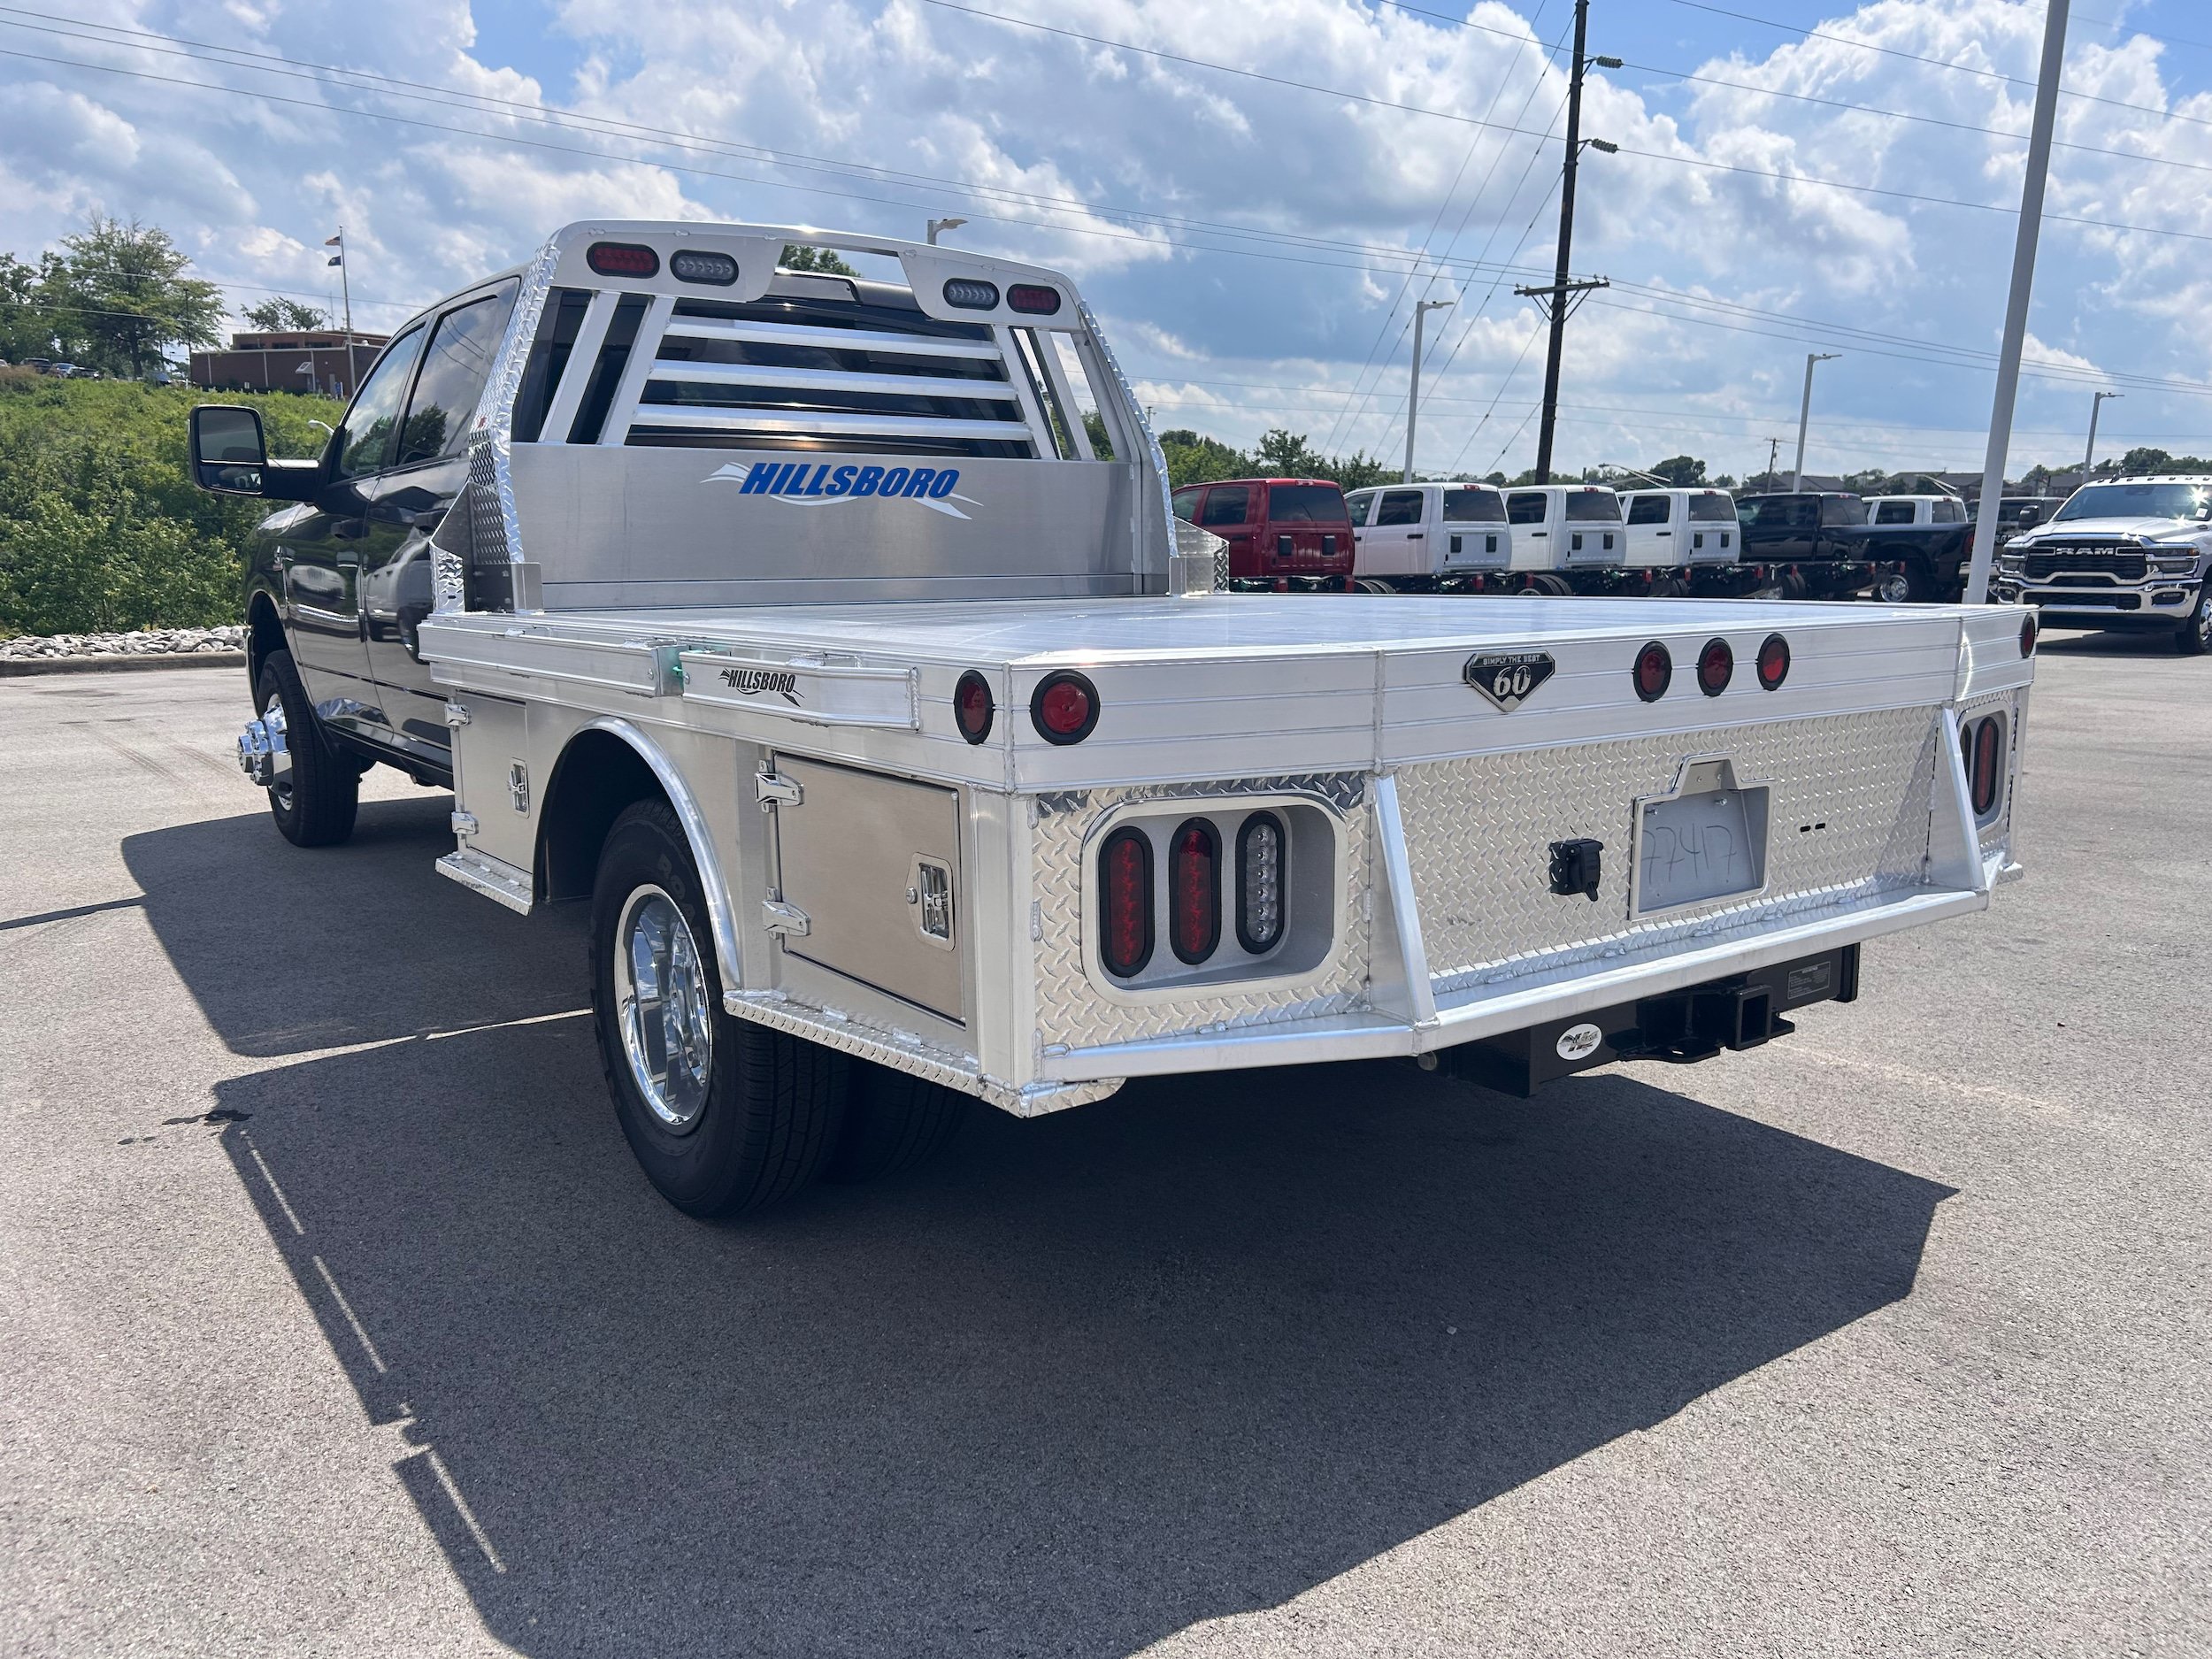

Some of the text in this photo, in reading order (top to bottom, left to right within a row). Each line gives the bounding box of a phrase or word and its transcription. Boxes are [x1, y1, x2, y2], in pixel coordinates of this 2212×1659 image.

[739, 462, 960, 499] HILLSBORO
[2055, 547, 2114, 556] RAM
[1482, 657, 1508, 665] SIMPLY
[1523, 654, 1540, 663] BEST
[727, 669, 796, 693] HILLSBORO
[1493, 664, 1532, 696] 60
